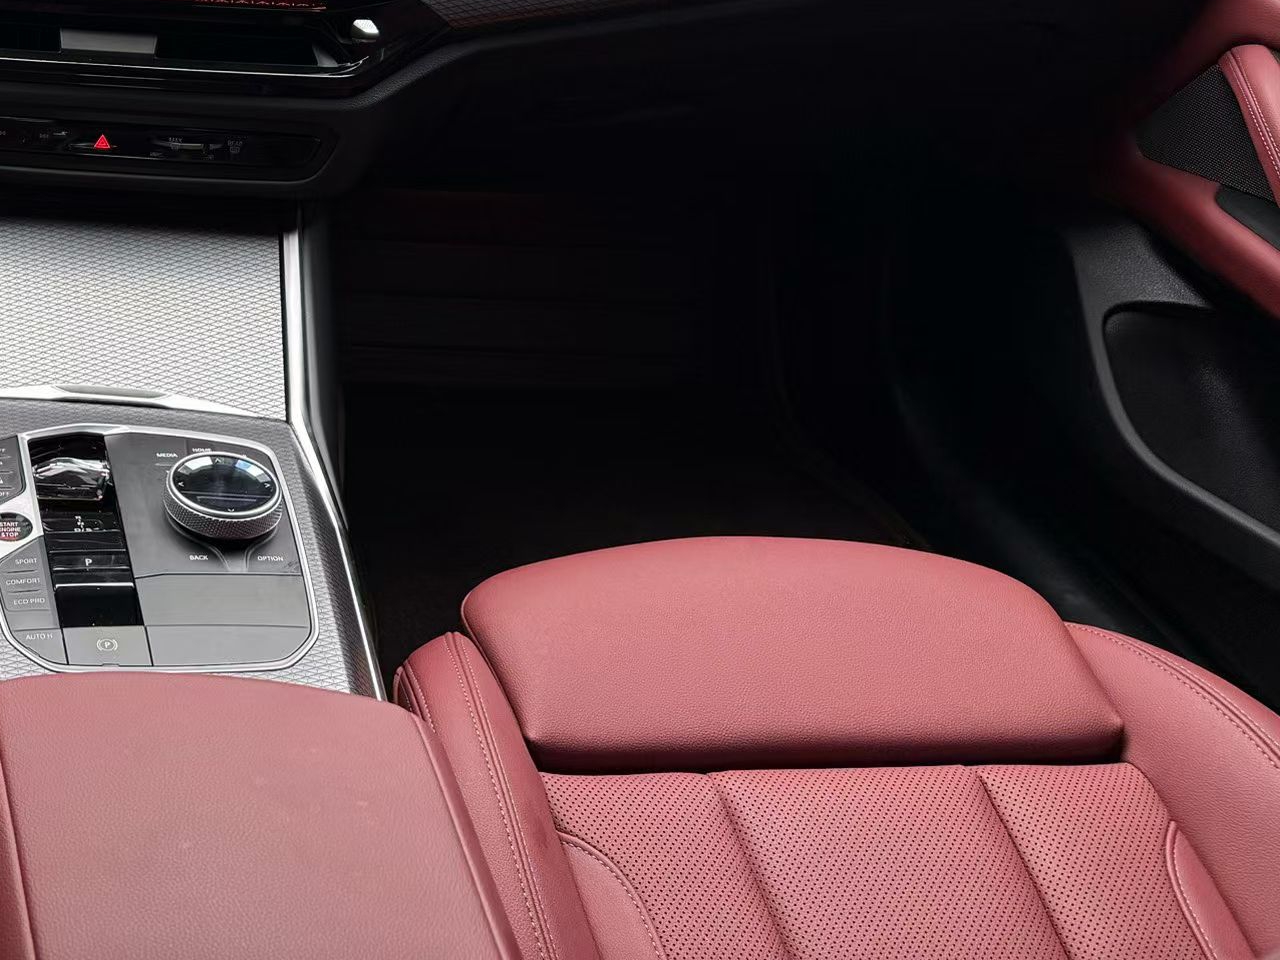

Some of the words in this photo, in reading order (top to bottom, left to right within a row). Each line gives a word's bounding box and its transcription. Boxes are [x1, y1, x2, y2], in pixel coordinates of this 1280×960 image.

[15, 557, 37, 565] SPORT
[84, 558, 93, 566] P
[5, 577, 41, 585] COMFORT
[13, 598, 28, 606] ECO
